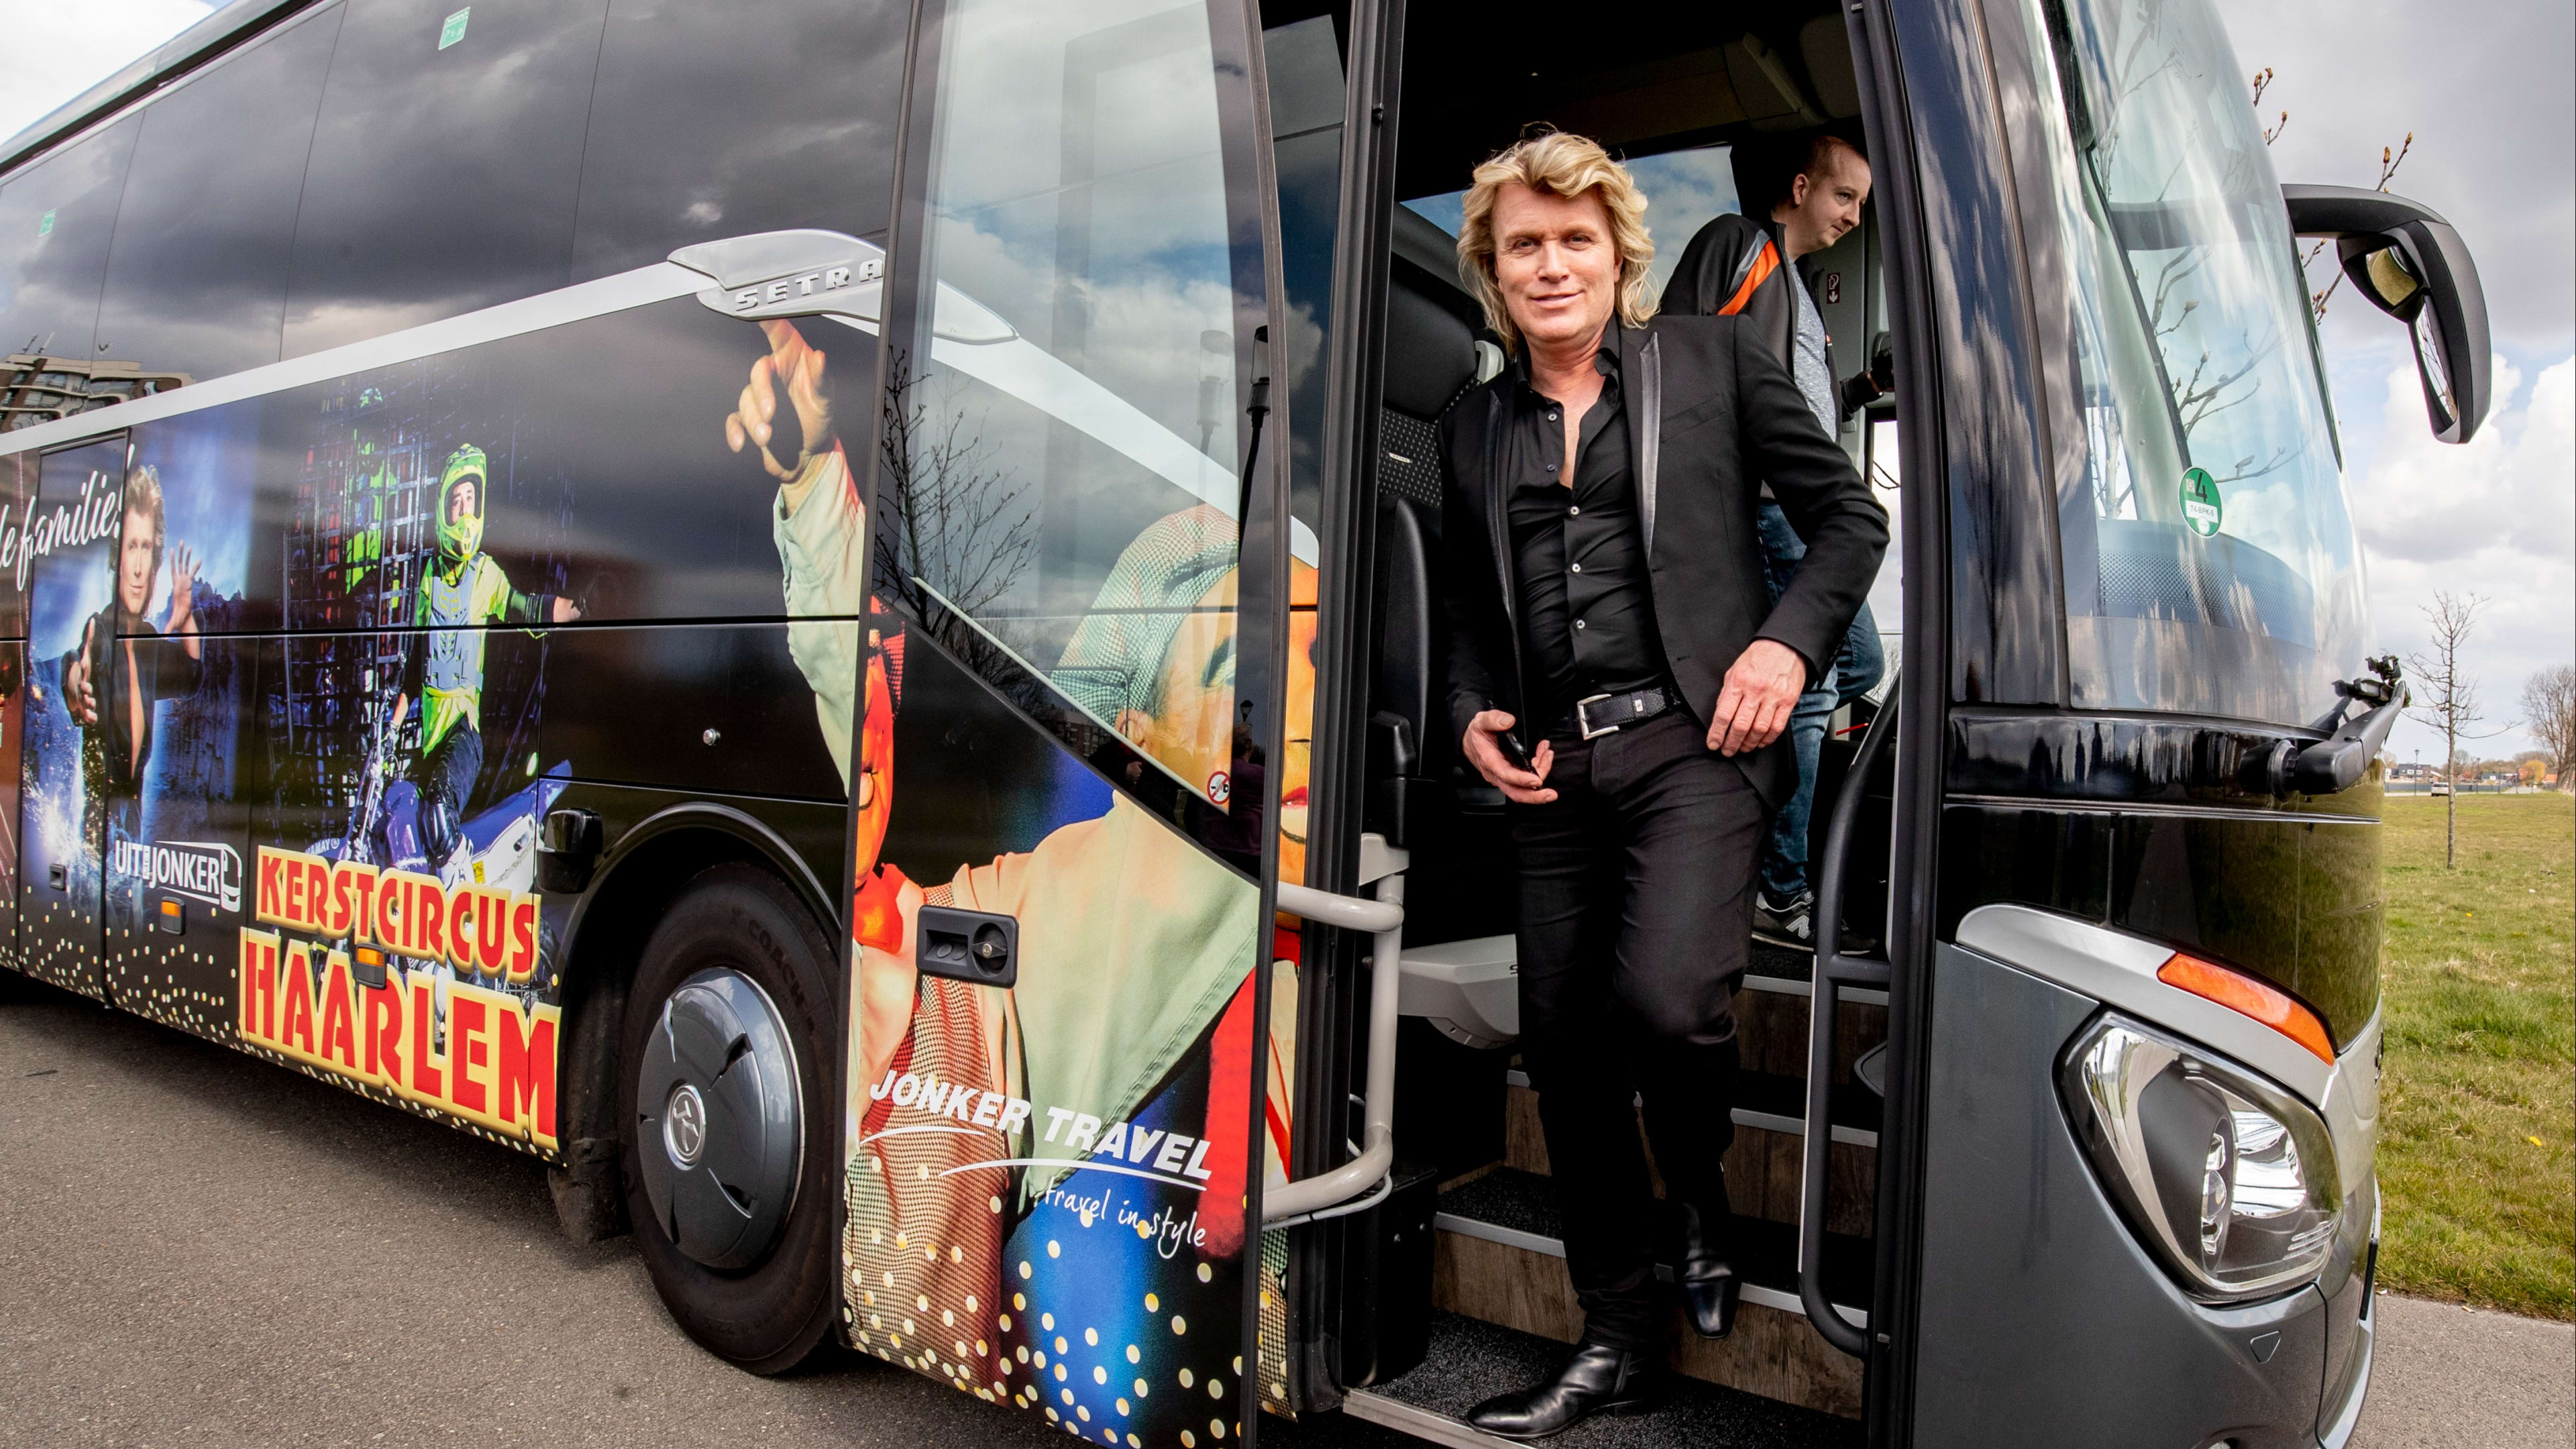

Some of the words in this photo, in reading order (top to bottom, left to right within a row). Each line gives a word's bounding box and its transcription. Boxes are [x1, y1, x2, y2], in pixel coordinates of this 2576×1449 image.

[735, 258, 883, 312] SETRA
[2195, 472, 2208, 502] 4
[115, 840, 143, 877] UIT
[150, 847, 220, 895] JONKER
[258, 848, 540, 982] KERSTCIRCUS
[240, 927, 561, 1151] HAARLEM
[870, 1070, 1032, 1134] JONKER
[1044, 1106, 1212, 1180] TRAVEL
[1044, 1175, 1111, 1220] travel
[1118, 1199, 1139, 1229] in
[1148, 1205, 1206, 1259] style
